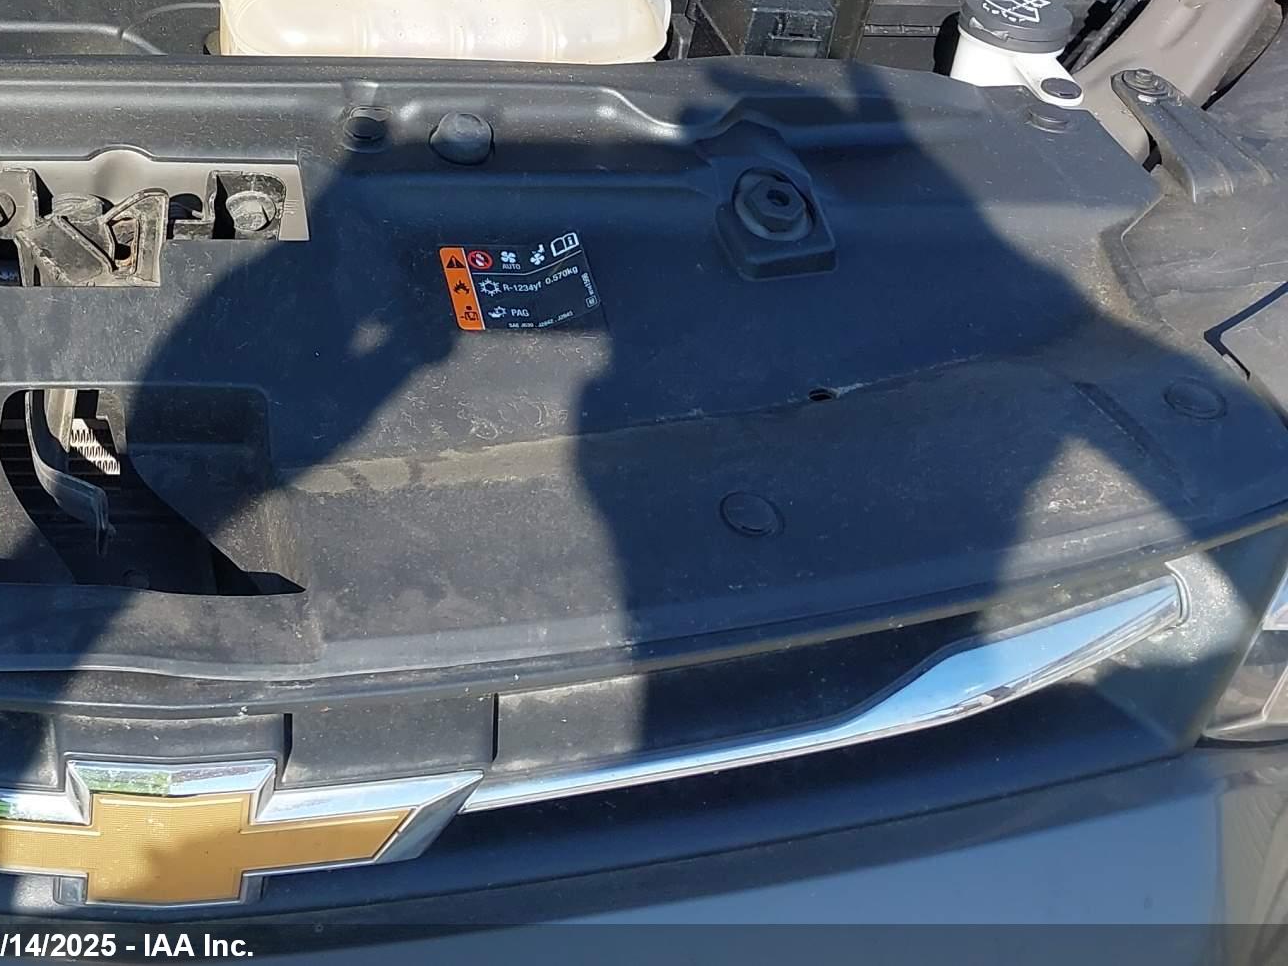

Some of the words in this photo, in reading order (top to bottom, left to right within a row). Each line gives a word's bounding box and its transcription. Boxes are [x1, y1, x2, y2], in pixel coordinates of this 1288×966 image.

[502, 281, 542, 292] R-1234yf
[545, 266, 579, 285] 0.570kg
[511, 309, 530, 317] PAG
